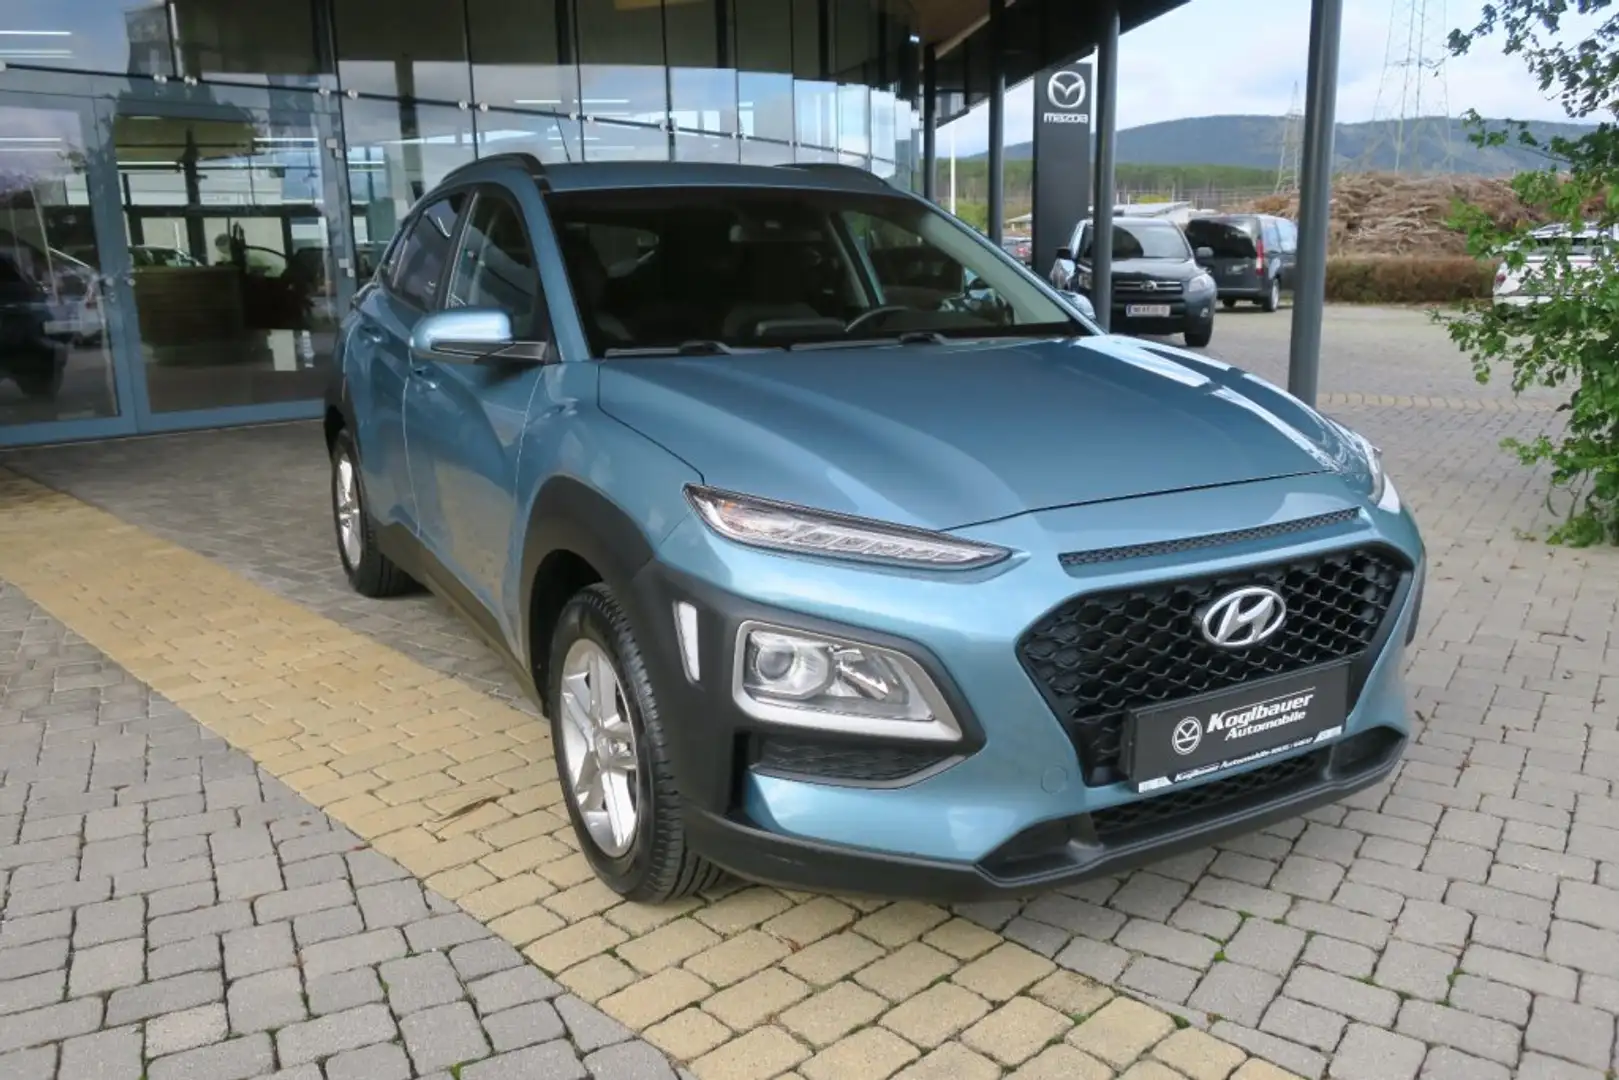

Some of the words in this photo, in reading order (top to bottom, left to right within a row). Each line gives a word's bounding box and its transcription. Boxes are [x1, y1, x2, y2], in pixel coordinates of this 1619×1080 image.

[1043, 112, 1089, 124] mazda
[1206, 694, 1314, 733] Koglbauer
[1224, 711, 1307, 741] Automobile
